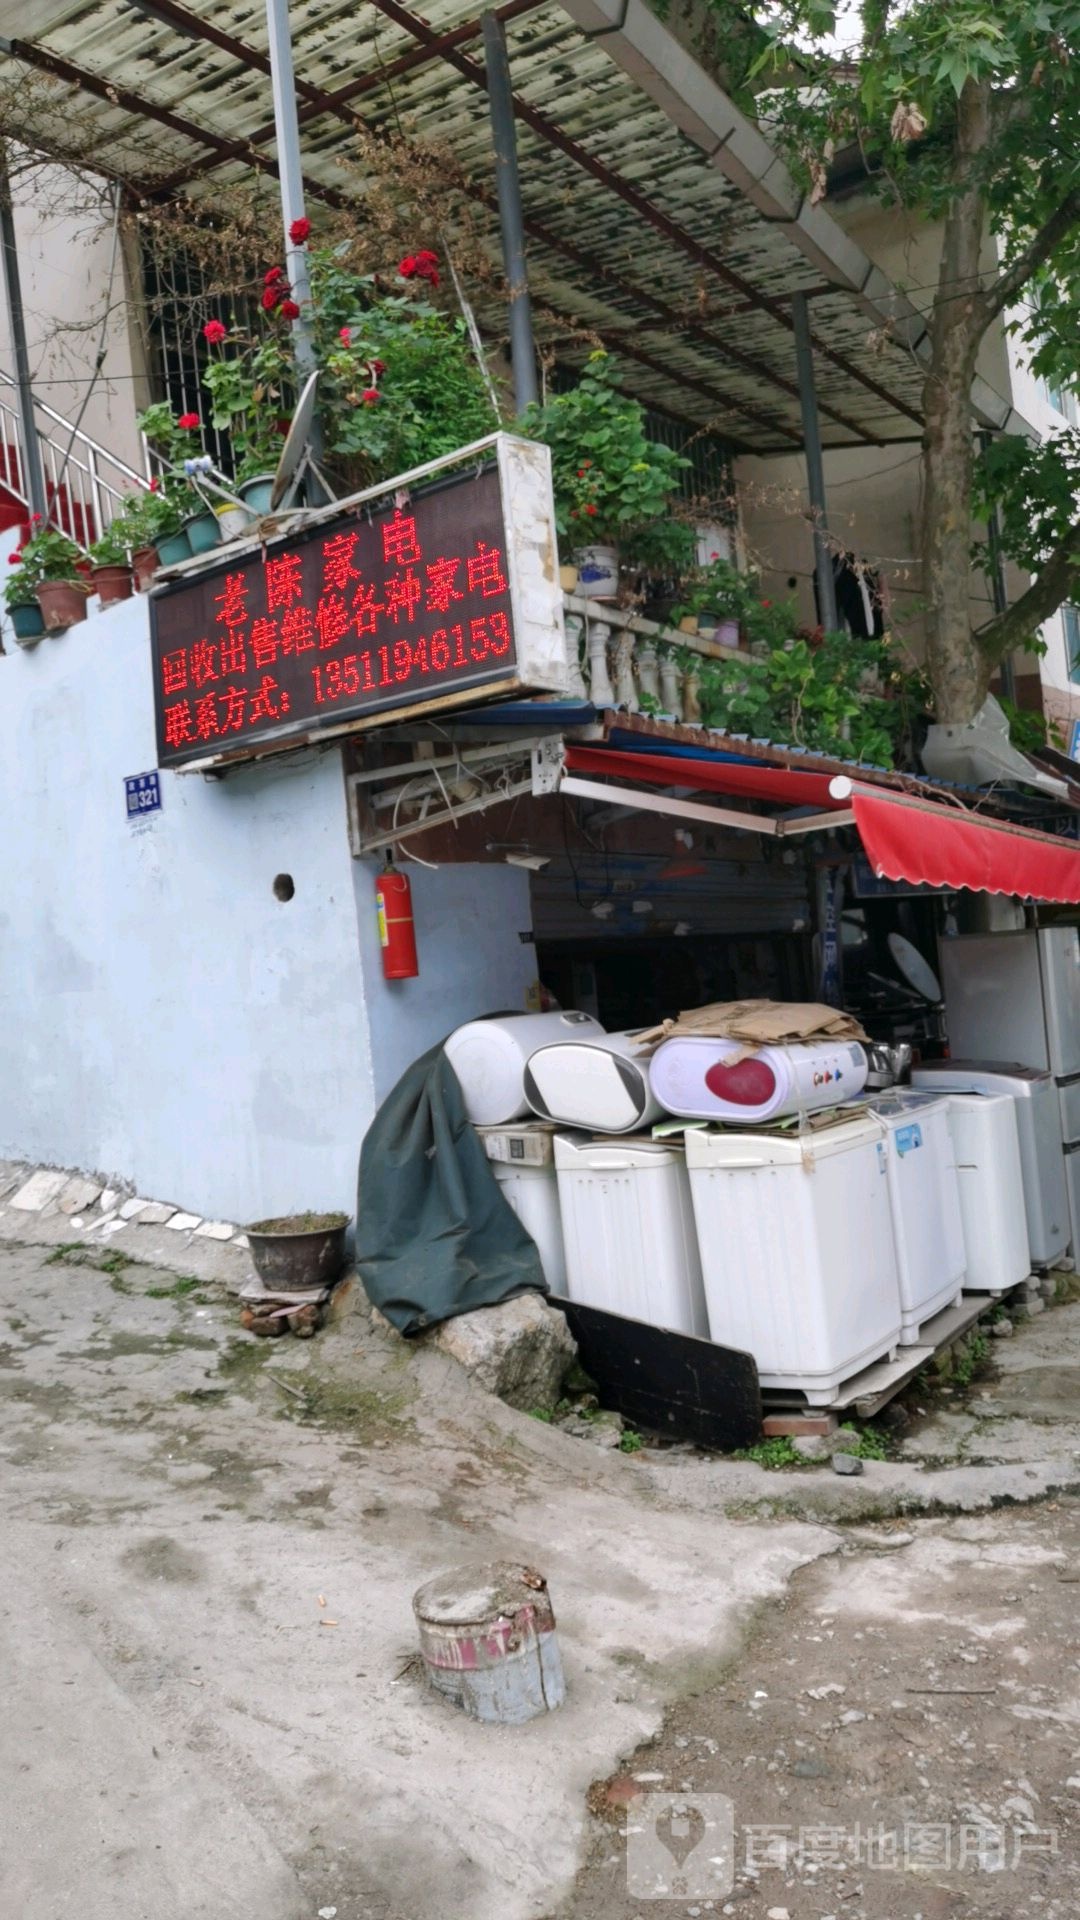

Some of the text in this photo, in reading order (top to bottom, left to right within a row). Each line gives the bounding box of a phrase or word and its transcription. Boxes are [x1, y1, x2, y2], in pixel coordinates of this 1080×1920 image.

[162, 542, 507, 695] 回收出售维修各种家电
[215, 508, 421, 627] 老陈家电
[311, 611, 510, 704] 13511946153
[138, 788, 158, 807] 321
